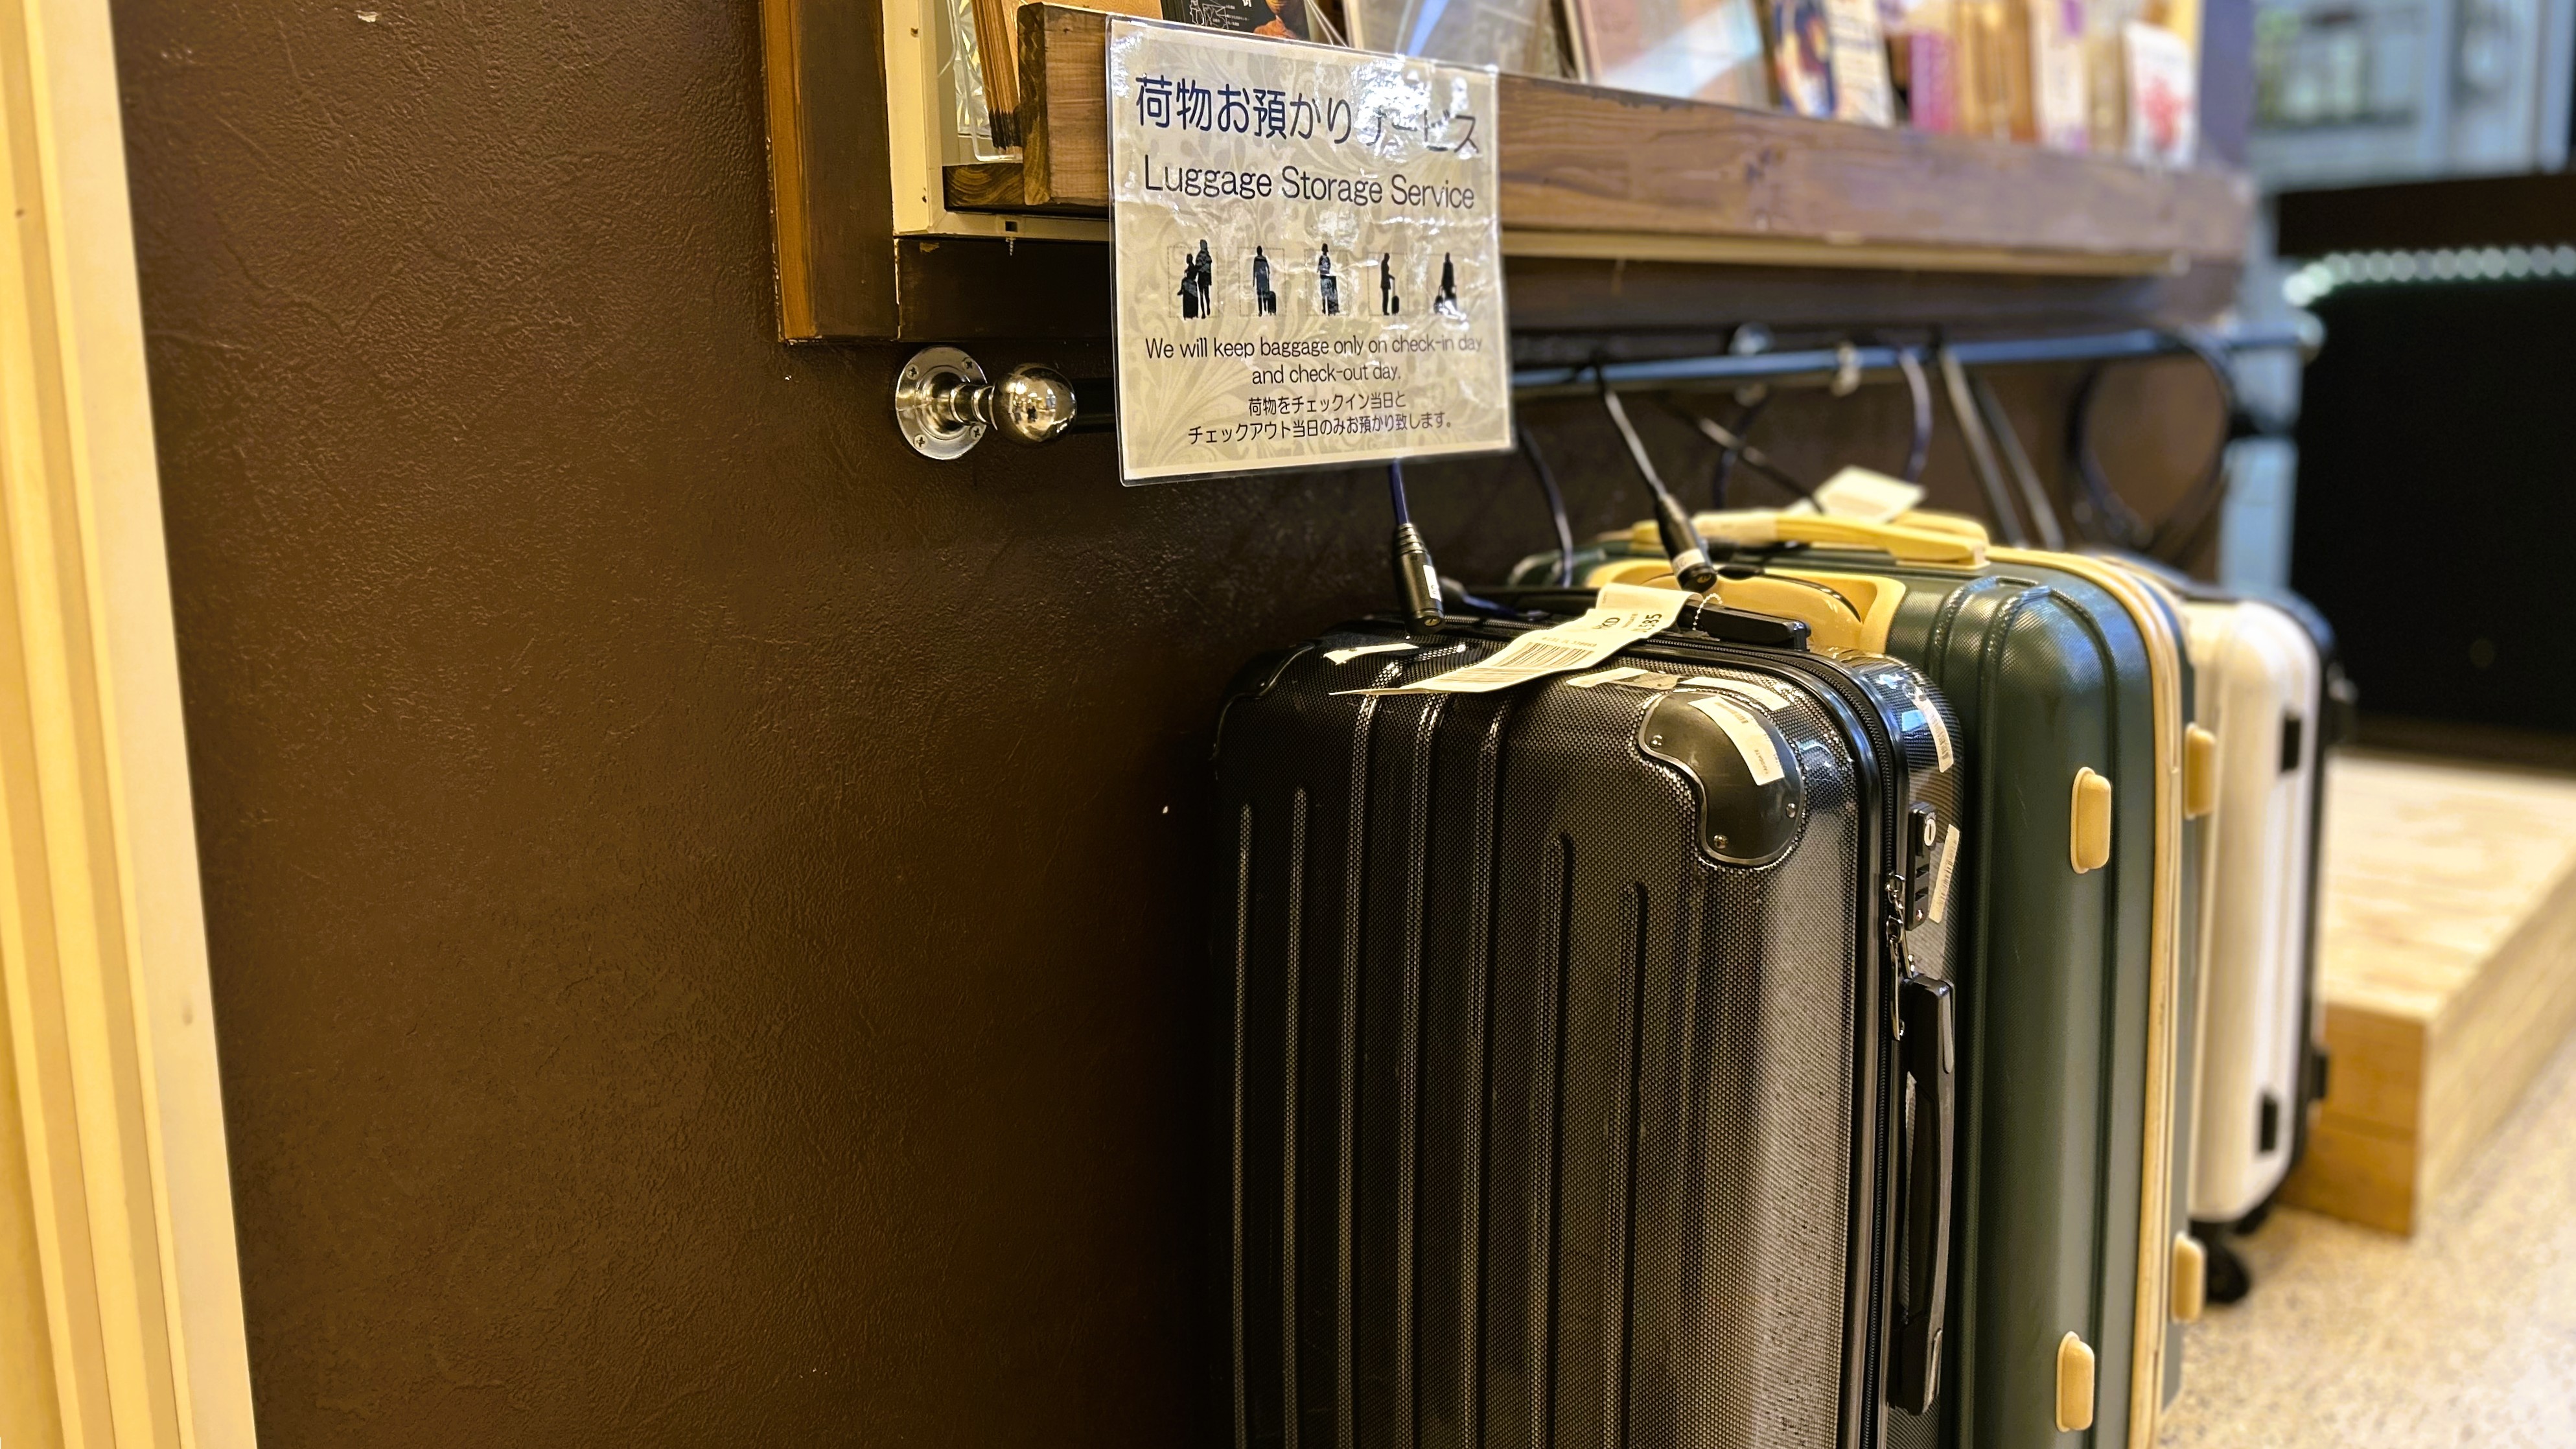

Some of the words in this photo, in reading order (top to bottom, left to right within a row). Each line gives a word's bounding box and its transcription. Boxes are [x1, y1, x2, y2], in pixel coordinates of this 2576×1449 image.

[1144, 154, 1272, 199] Luggage
[1281, 165, 1383, 206] Storage
[1391, 174, 1475, 209] Service
[1145, 337, 1174, 359] We
[1179, 336, 1208, 358] will
[1213, 336, 1255, 358] keep
[1260, 336, 1329, 357] baggage
[1334, 334, 1364, 356] only
[1368, 339, 1387, 354] on
[1392, 334, 1454, 353] check-in
[1458, 334, 1483, 353] day
[1251, 364, 1284, 384] and
[1289, 362, 1369, 384] check-out
[1373, 361, 1402, 382] day.
[1247, 390, 1406, 417] 荷物をチェックイン当日と
[1188, 410, 1451, 445] チェックアウト当日のみお預かり致します。
